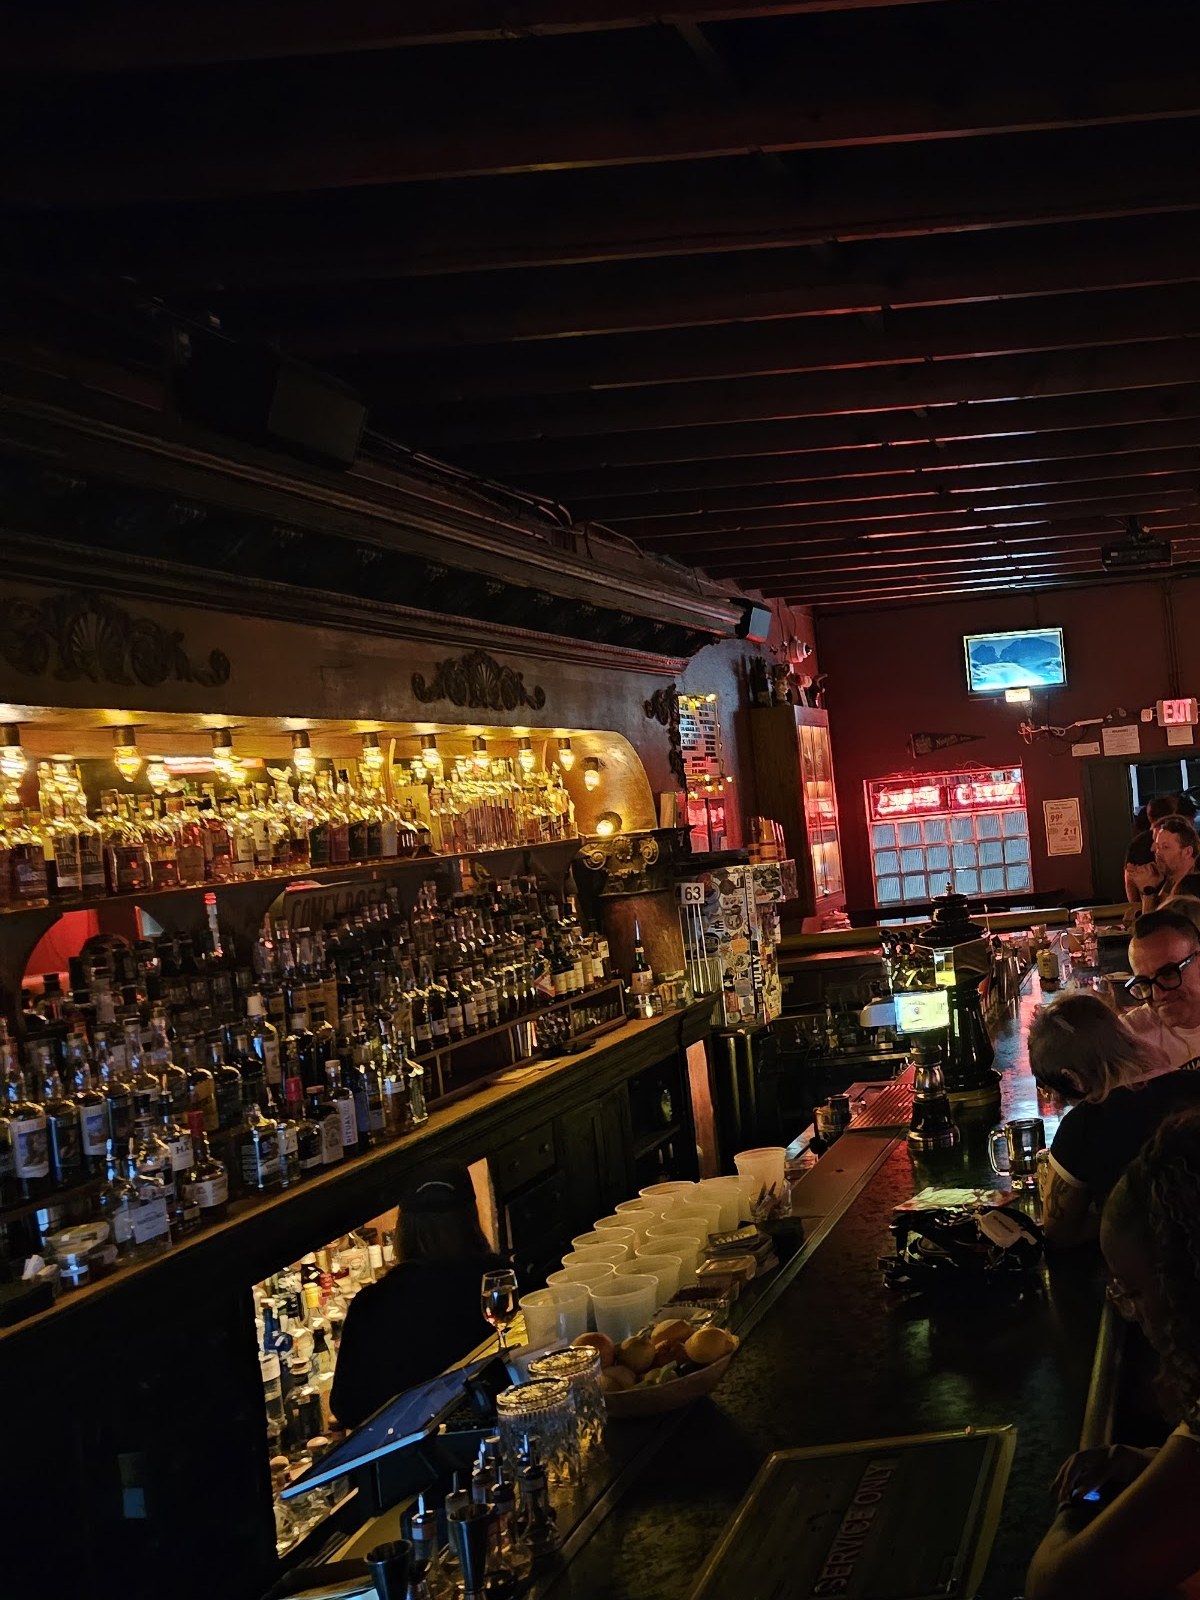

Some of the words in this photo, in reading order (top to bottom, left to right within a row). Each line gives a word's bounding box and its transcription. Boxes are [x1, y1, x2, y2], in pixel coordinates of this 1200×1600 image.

[1162, 699, 1192, 723] EXIT
[684, 885, 702, 902] 63
[752, 954, 763, 990] TULLY
[814, 1507, 877, 1593] SERVICE
[854, 1463, 896, 1505] ONLY
